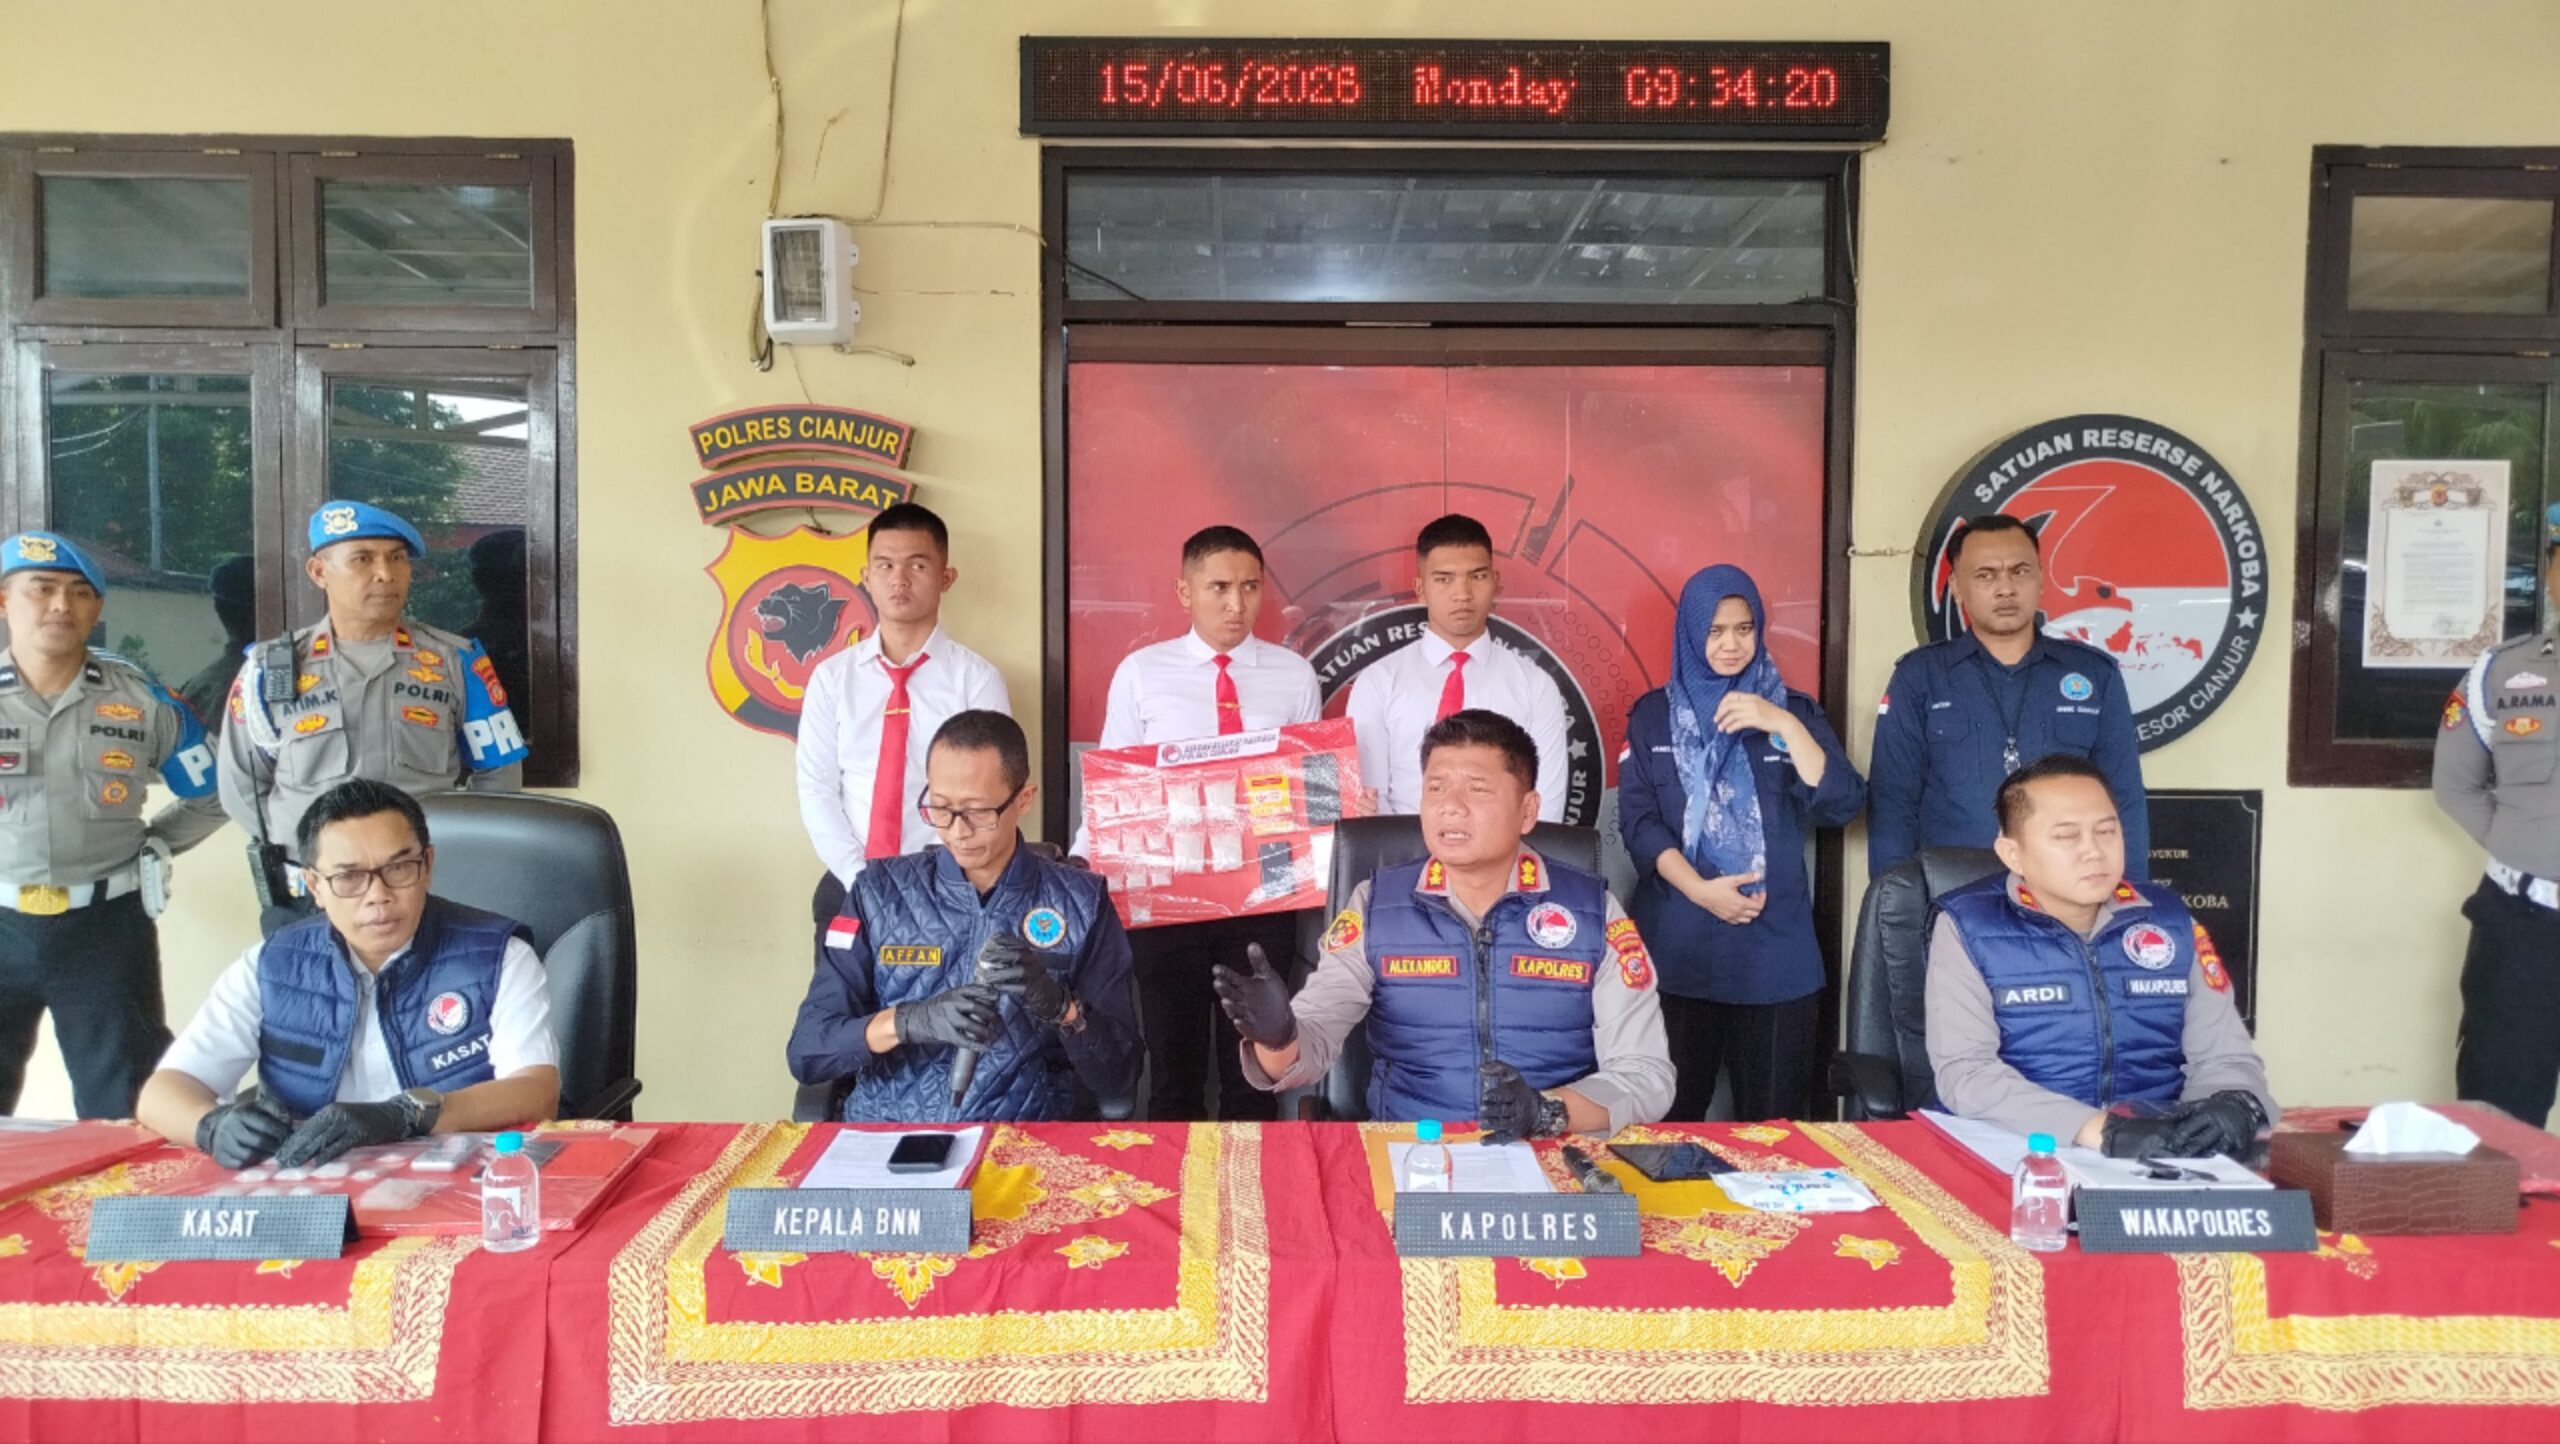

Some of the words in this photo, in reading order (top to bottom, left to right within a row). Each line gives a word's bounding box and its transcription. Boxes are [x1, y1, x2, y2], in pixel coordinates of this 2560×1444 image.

[1414, 64, 1576, 114] Monday
[1626, 68, 1839, 107] 09:34:20
[699, 416, 791, 455] POLRES
[799, 416, 900, 455] CIANJUR
[704, 473, 787, 513] JAWA
[795, 473, 899, 510] BARAT
[1974, 433, 2073, 503] SATUAN
[2083, 428, 2204, 477] RESERSE
[2200, 471, 2261, 598] NARKOBA
[1316, 633, 1381, 684] ATUAN
[394, 682, 450, 703] POLRI
[2135, 705, 2191, 742] ESOR
[2189, 634, 2250, 710] CIANJUR
[2497, 694, 2557, 710] A.RAMA
[90, 725, 145, 742] POLRI
[2181, 894, 2230, 909] KOBA
[885, 949, 938, 962] AFFAN
[1388, 959, 1452, 974] ALEXANDER
[1516, 958, 1585, 979] KAPOLRES
[2005, 985, 2064, 1004] ARDI
[2130, 978, 2188, 995] WAKAPOLRES
[430, 1033, 492, 1070] KASAT
[182, 1208, 260, 1238] KASAT
[773, 1207, 864, 1236] KEPALA
[875, 1207, 921, 1235] BNN
[1440, 1211, 1598, 1241] KAPOLRES
[2120, 1207, 2272, 1238] WAKAPOLRES
